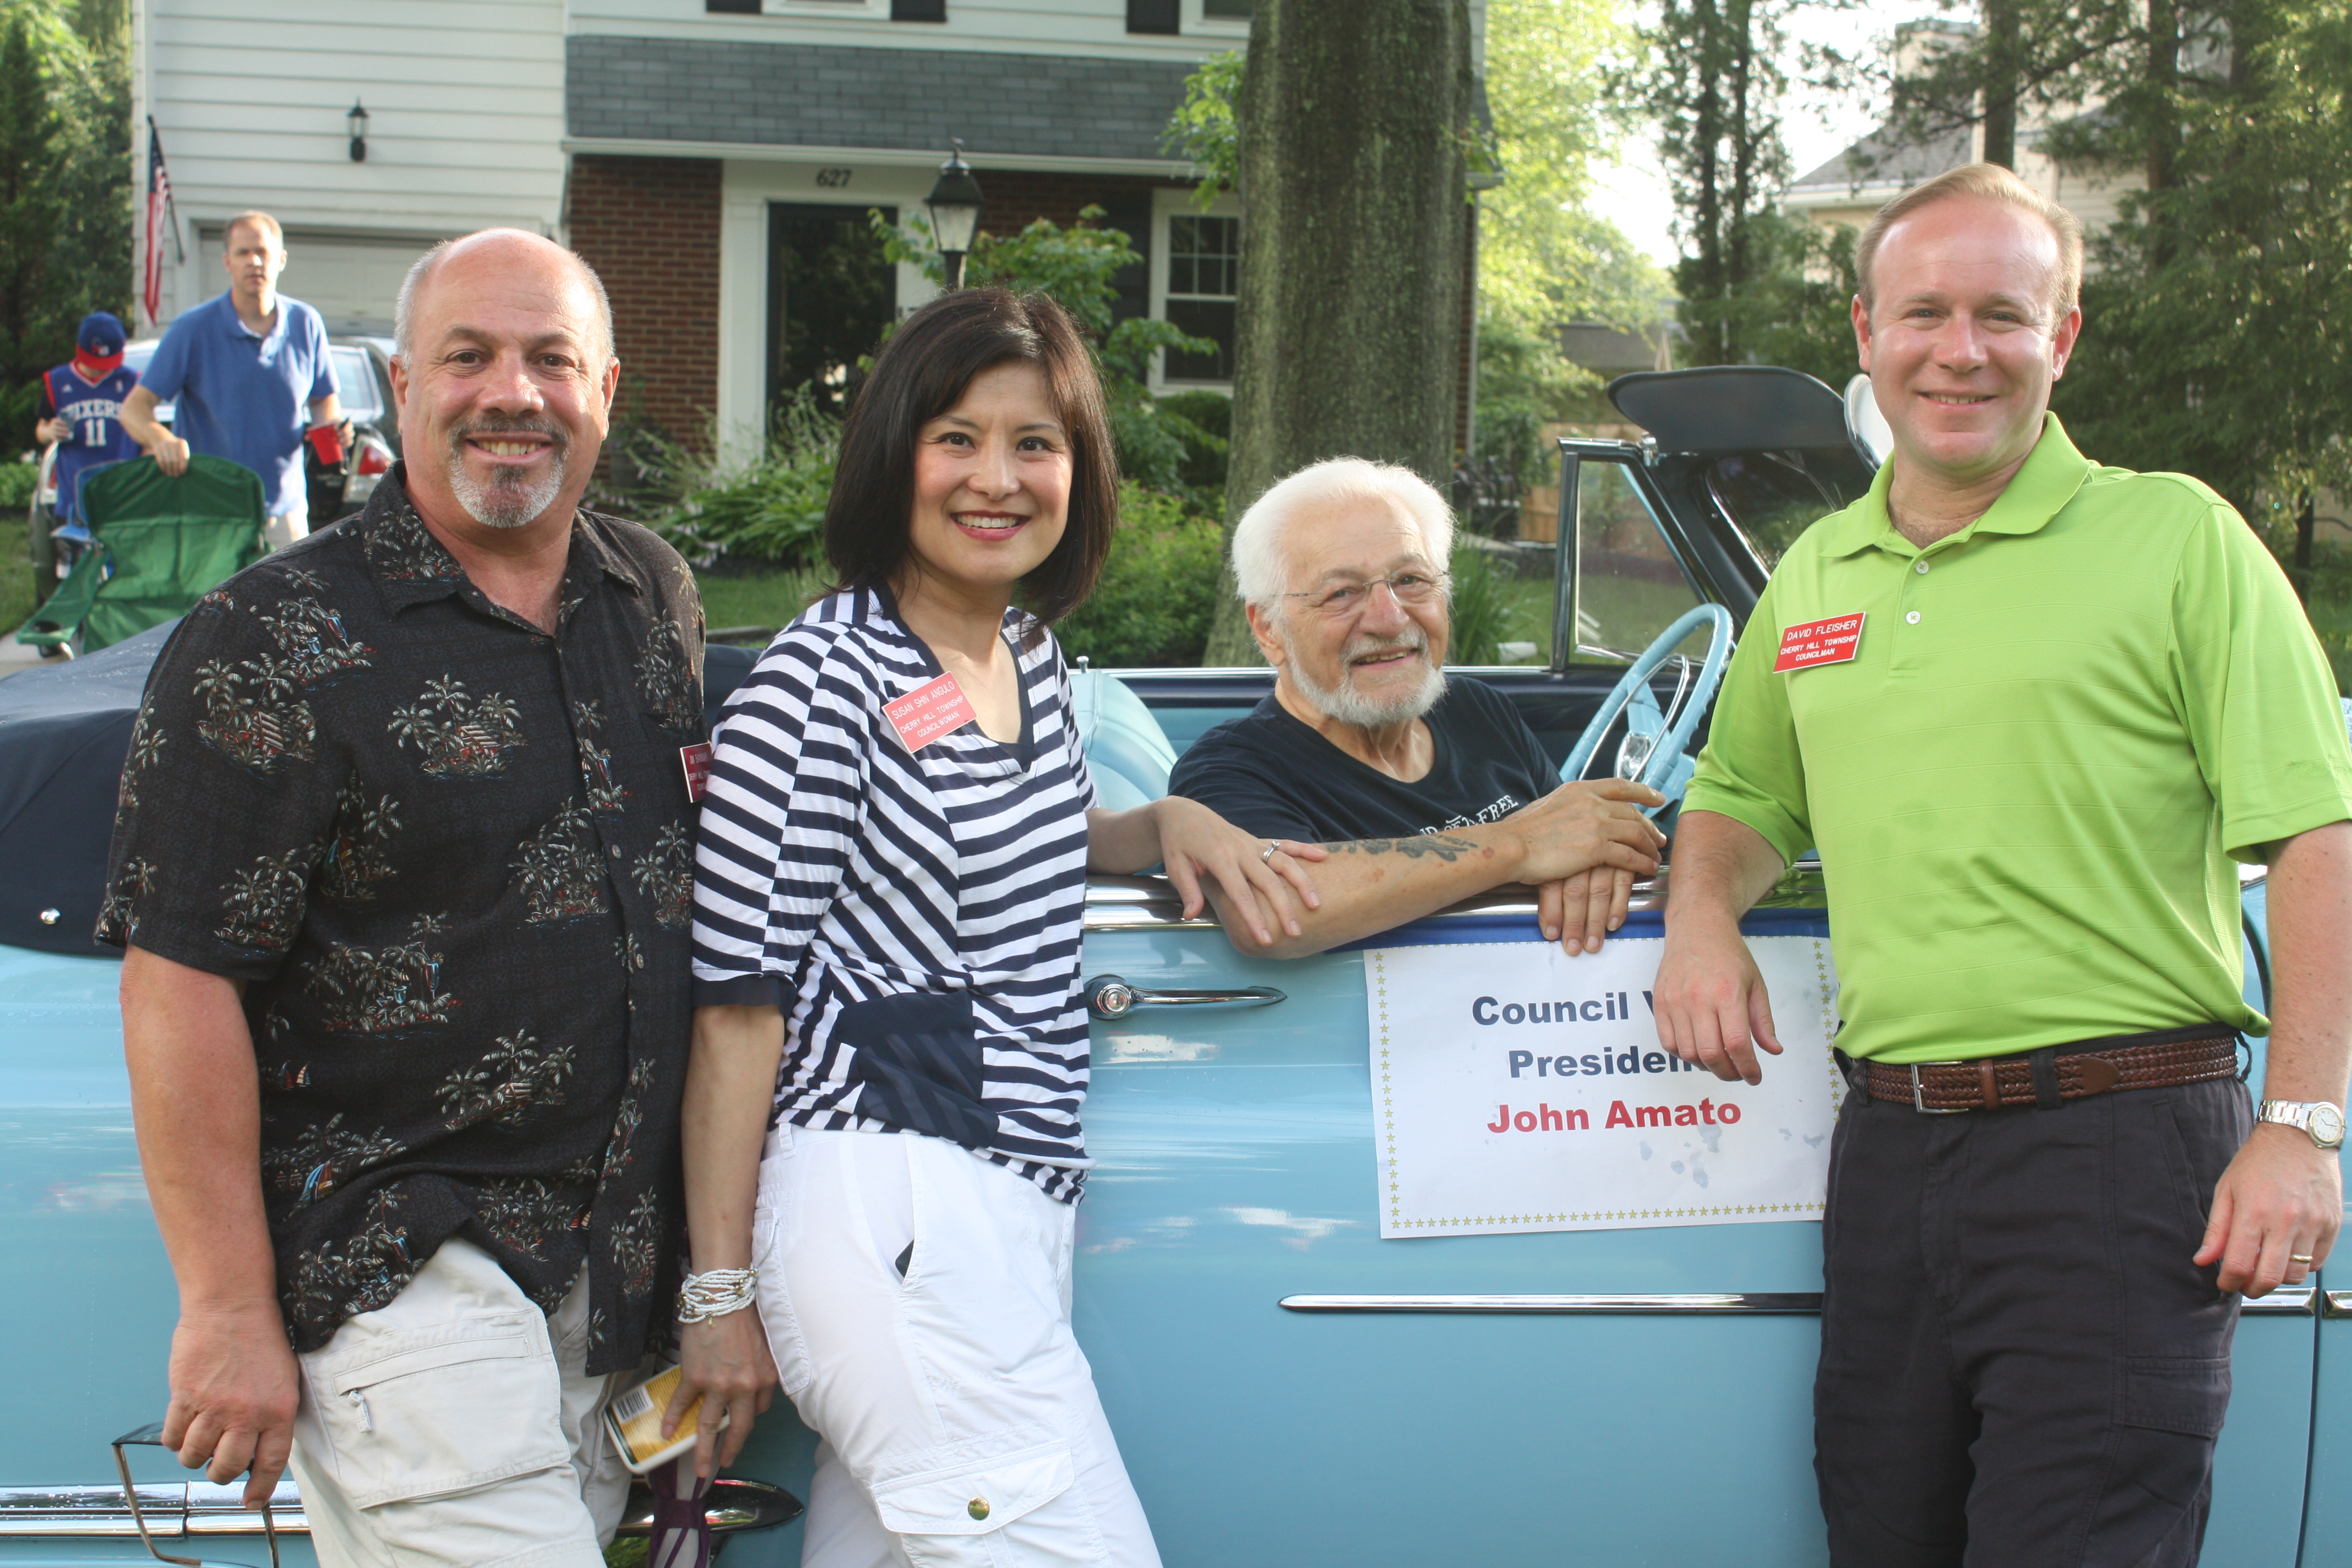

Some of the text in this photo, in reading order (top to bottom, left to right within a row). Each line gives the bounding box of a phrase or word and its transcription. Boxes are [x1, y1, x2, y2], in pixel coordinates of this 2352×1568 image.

[816, 168, 853, 187] 627
[85, 418, 107, 447] 11
[1780, 634, 1857, 655] CHERRY HILL TOWNSHIP
[1787, 619, 1858, 641] DAVID FLEISHER
[1795, 647, 1836, 661] COUNCILMAN
[891, 681, 955, 719] SUSAN SHIN ANGULO
[900, 695, 963, 734] CHERRY HILL TOWNSHIP
[1476, 794, 1519, 824] FREE
[1472, 991, 1629, 1026] Council
[1509, 1045, 1710, 1079] Presiden
[1487, 1097, 1742, 1134] John Amato
